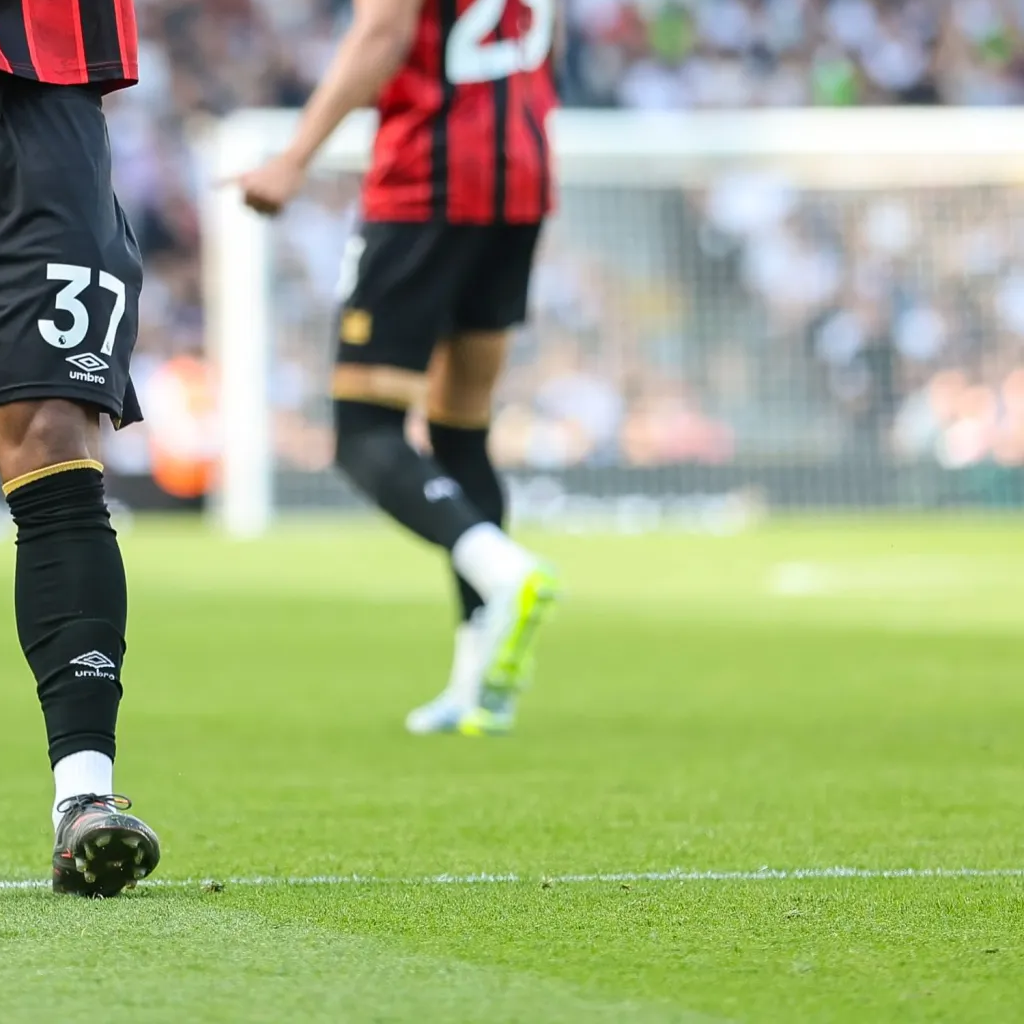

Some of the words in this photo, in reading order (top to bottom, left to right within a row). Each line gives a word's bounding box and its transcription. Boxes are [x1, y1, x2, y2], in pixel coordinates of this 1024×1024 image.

[37, 263, 126, 357] 37
[69, 370, 106, 385] umbro
[74, 668, 115, 681] umbro
